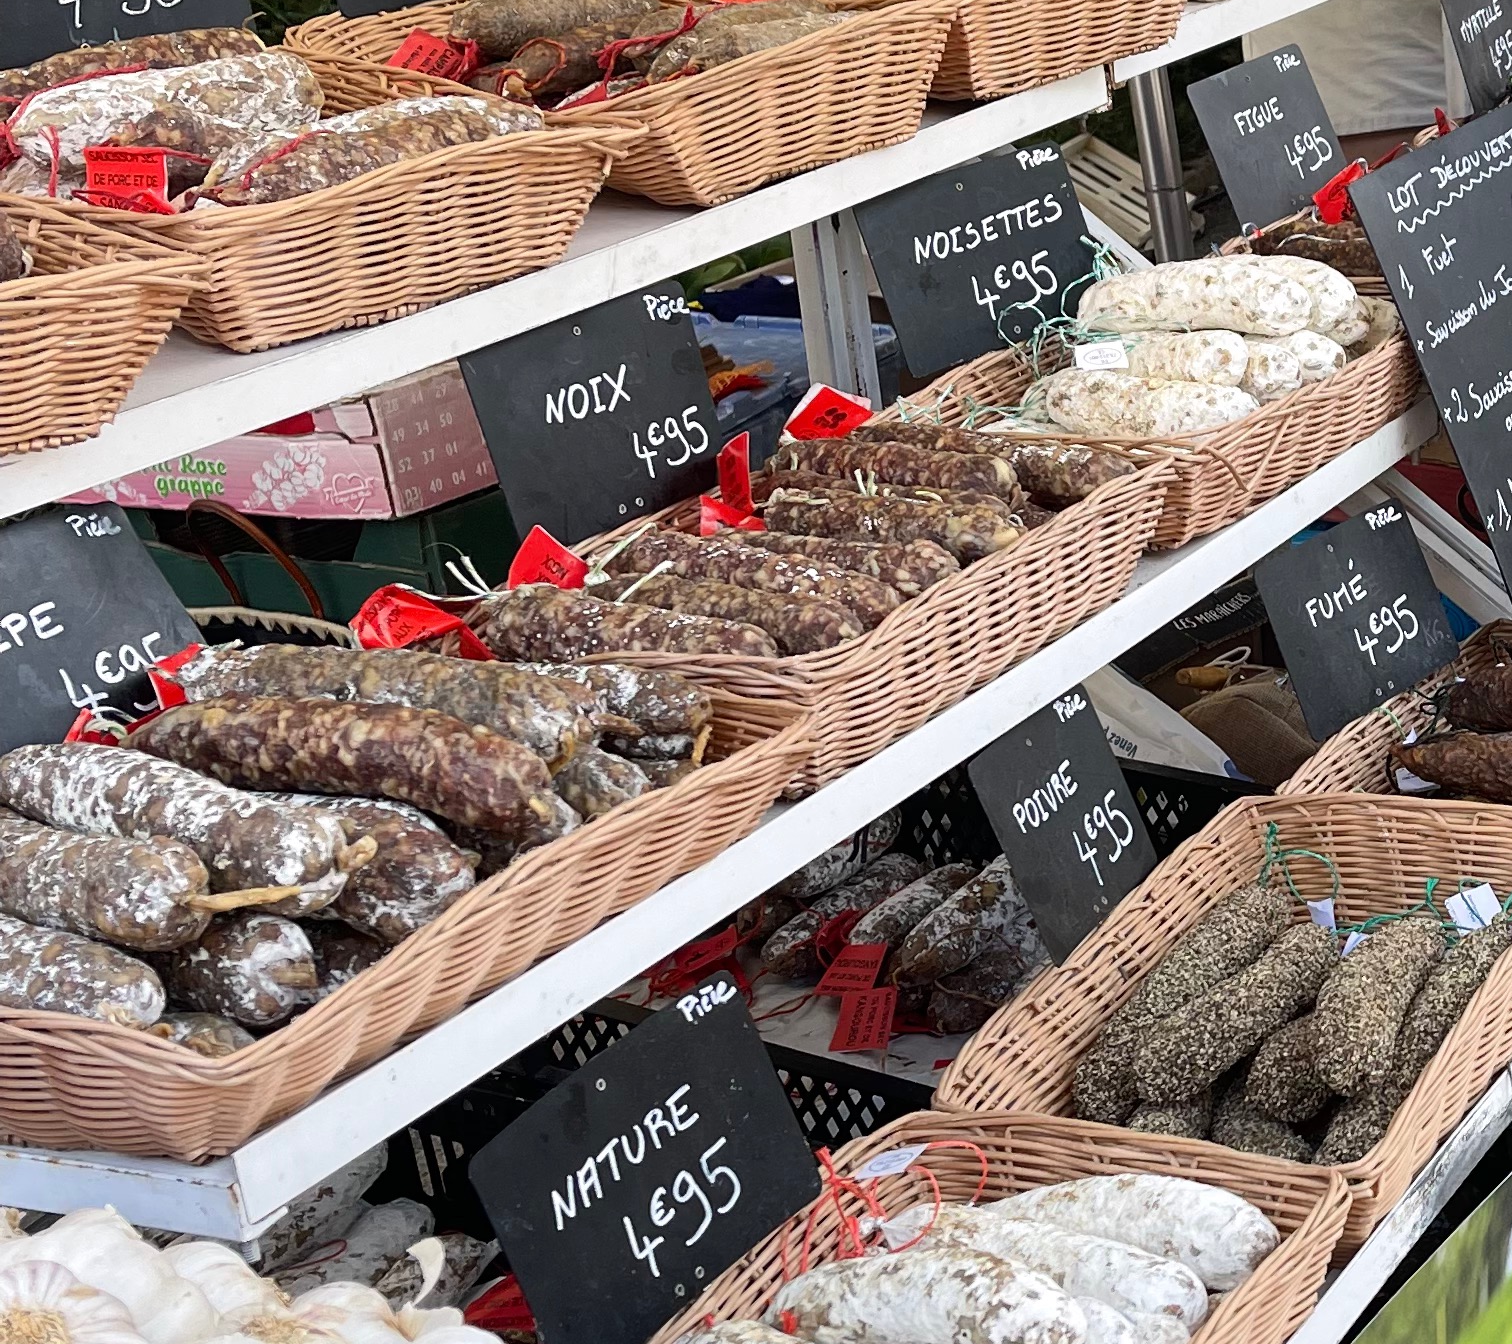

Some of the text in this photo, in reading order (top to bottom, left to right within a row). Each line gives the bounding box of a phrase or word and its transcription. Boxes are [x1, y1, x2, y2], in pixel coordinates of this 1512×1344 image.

[1233, 96, 1284, 136] FIGUE
[94, 173, 106, 185] DE
[133, 174, 143, 186] ET
[146, 175, 158, 188] DE
[1284, 126, 1333, 179] 4€95
[1387, 172, 1422, 214] LOT
[914, 193, 1063, 264] NOISETTES
[1422, 234, 1457, 276] Fuet
[972, 250, 1057, 321] 4€95
[1426, 302, 1478, 348] Saucisson
[1479, 280, 1497, 312] du
[440, 412, 452, 428] 50
[546, 364, 631, 424] NOIX
[178, 453, 227, 476] Rose
[398, 441, 458, 474] 52 37 01
[632, 406, 709, 478] 4€95
[156, 476, 225, 499] grappe
[429, 478, 443, 494] 40
[452, 469, 466, 485] 04
[475, 461, 488, 477] 41
[1305, 557, 1368, 627] FUMÉ
[1354, 594, 1419, 666] 4€95
[1108, 729, 1139, 759] Venez
[1013, 759, 1078, 834] POIVRE
[1072, 789, 1134, 886] 4€95
[551, 1083, 699, 1231] NATURE
[623, 1136, 741, 1277] 4€95
